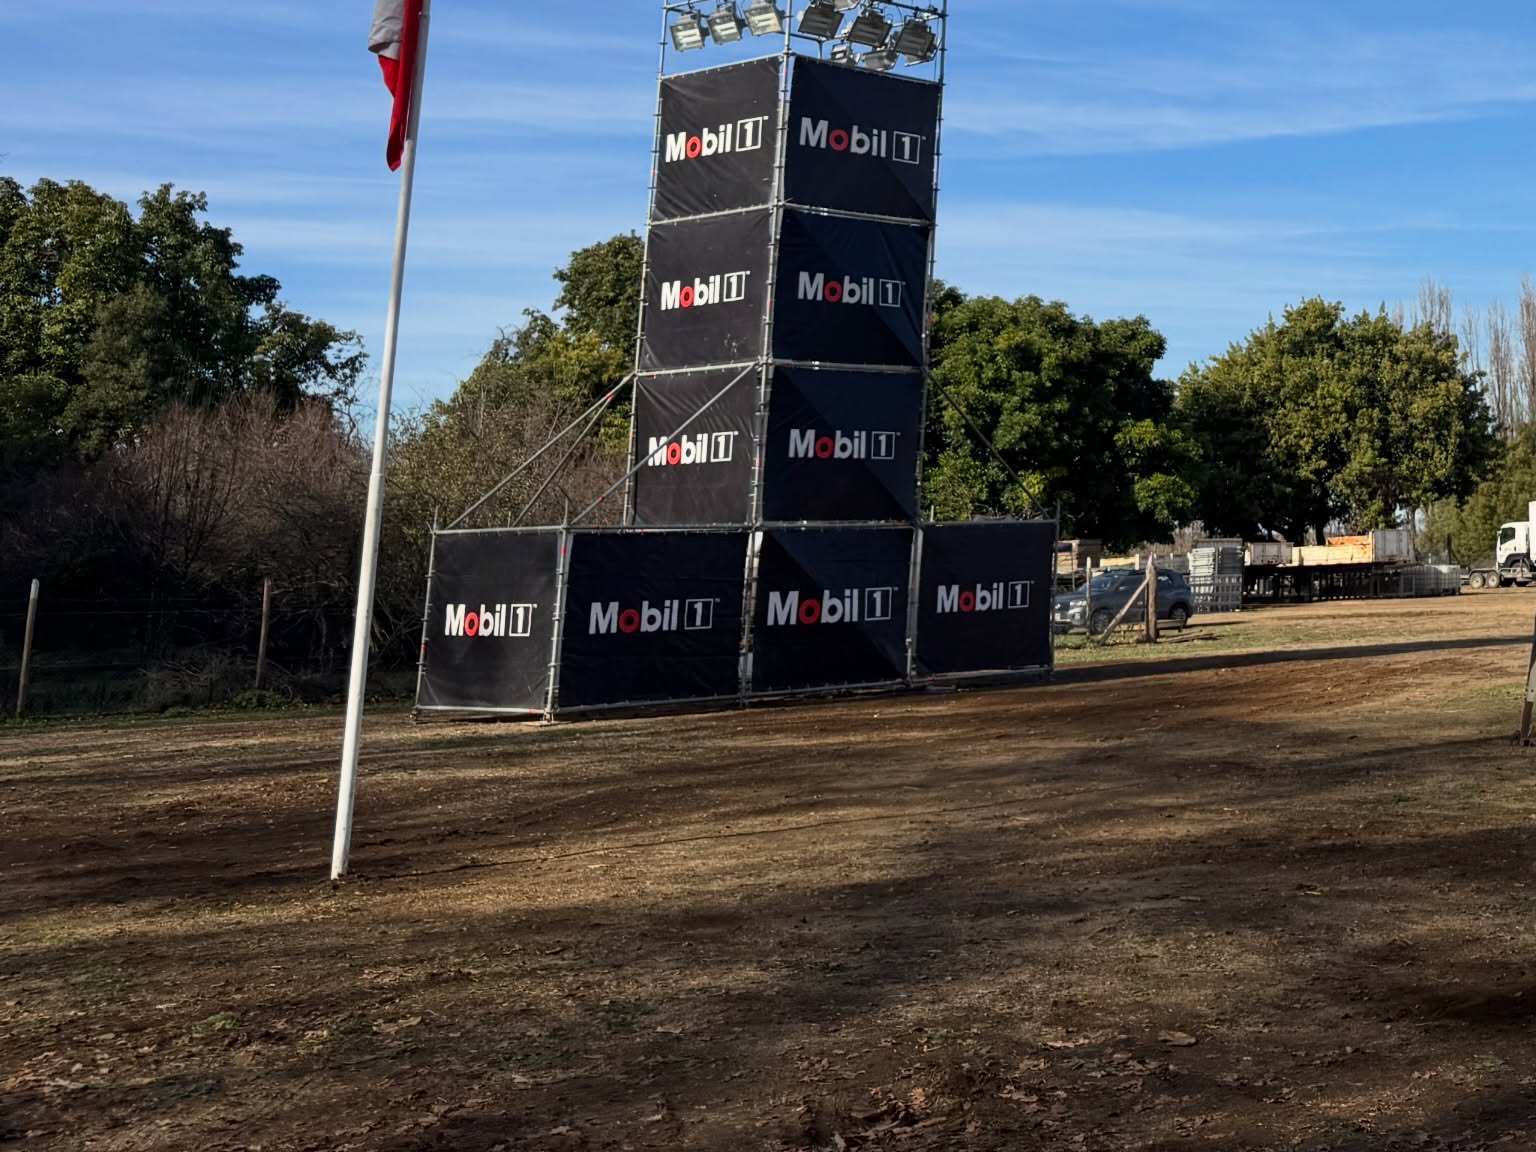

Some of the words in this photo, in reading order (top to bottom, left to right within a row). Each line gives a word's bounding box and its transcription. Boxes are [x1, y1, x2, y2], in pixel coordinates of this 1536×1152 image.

[665, 124, 732, 162] Mobil
[799, 117, 886, 157] Mobil
[660, 274, 721, 310] Mobil
[797, 271, 874, 305] Mobil
[648, 433, 708, 466] Mobil
[788, 428, 866, 459] Mobil
[767, 588, 859, 626] Mobil
[936, 582, 1004, 614] Mobil
[444, 603, 506, 637] Mobil
[588, 599, 679, 635] Mobil
